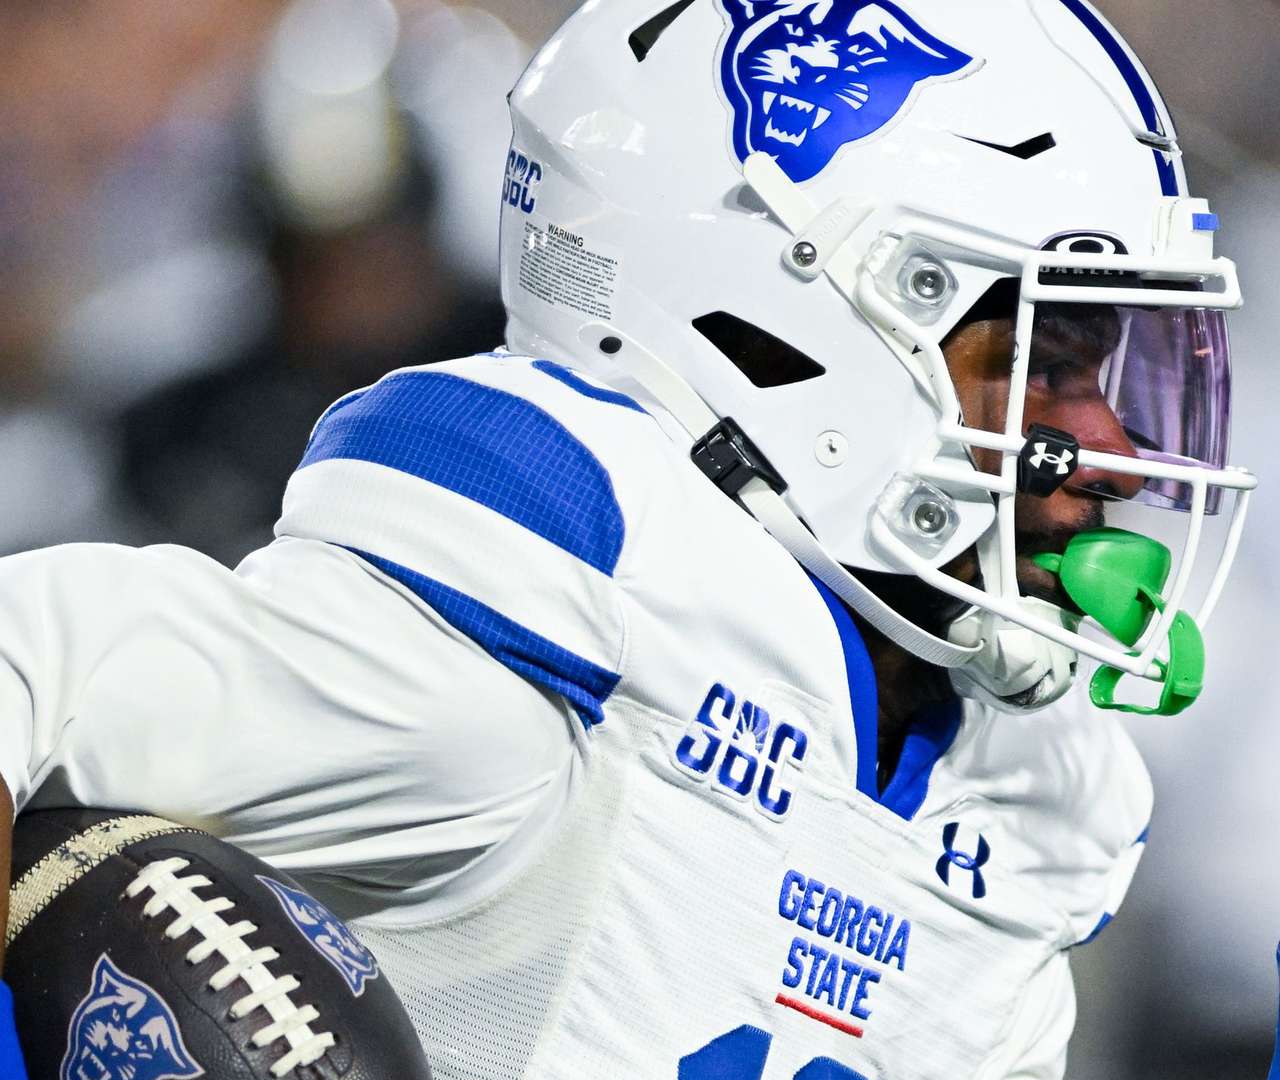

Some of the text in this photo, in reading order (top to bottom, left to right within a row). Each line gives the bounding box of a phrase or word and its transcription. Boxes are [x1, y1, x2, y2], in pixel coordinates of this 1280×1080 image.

[548, 223, 584, 247] WARNING
[675, 682, 808, 816] SBC
[778, 869, 912, 971] GEORGIA
[782, 937, 882, 1020] STATE
